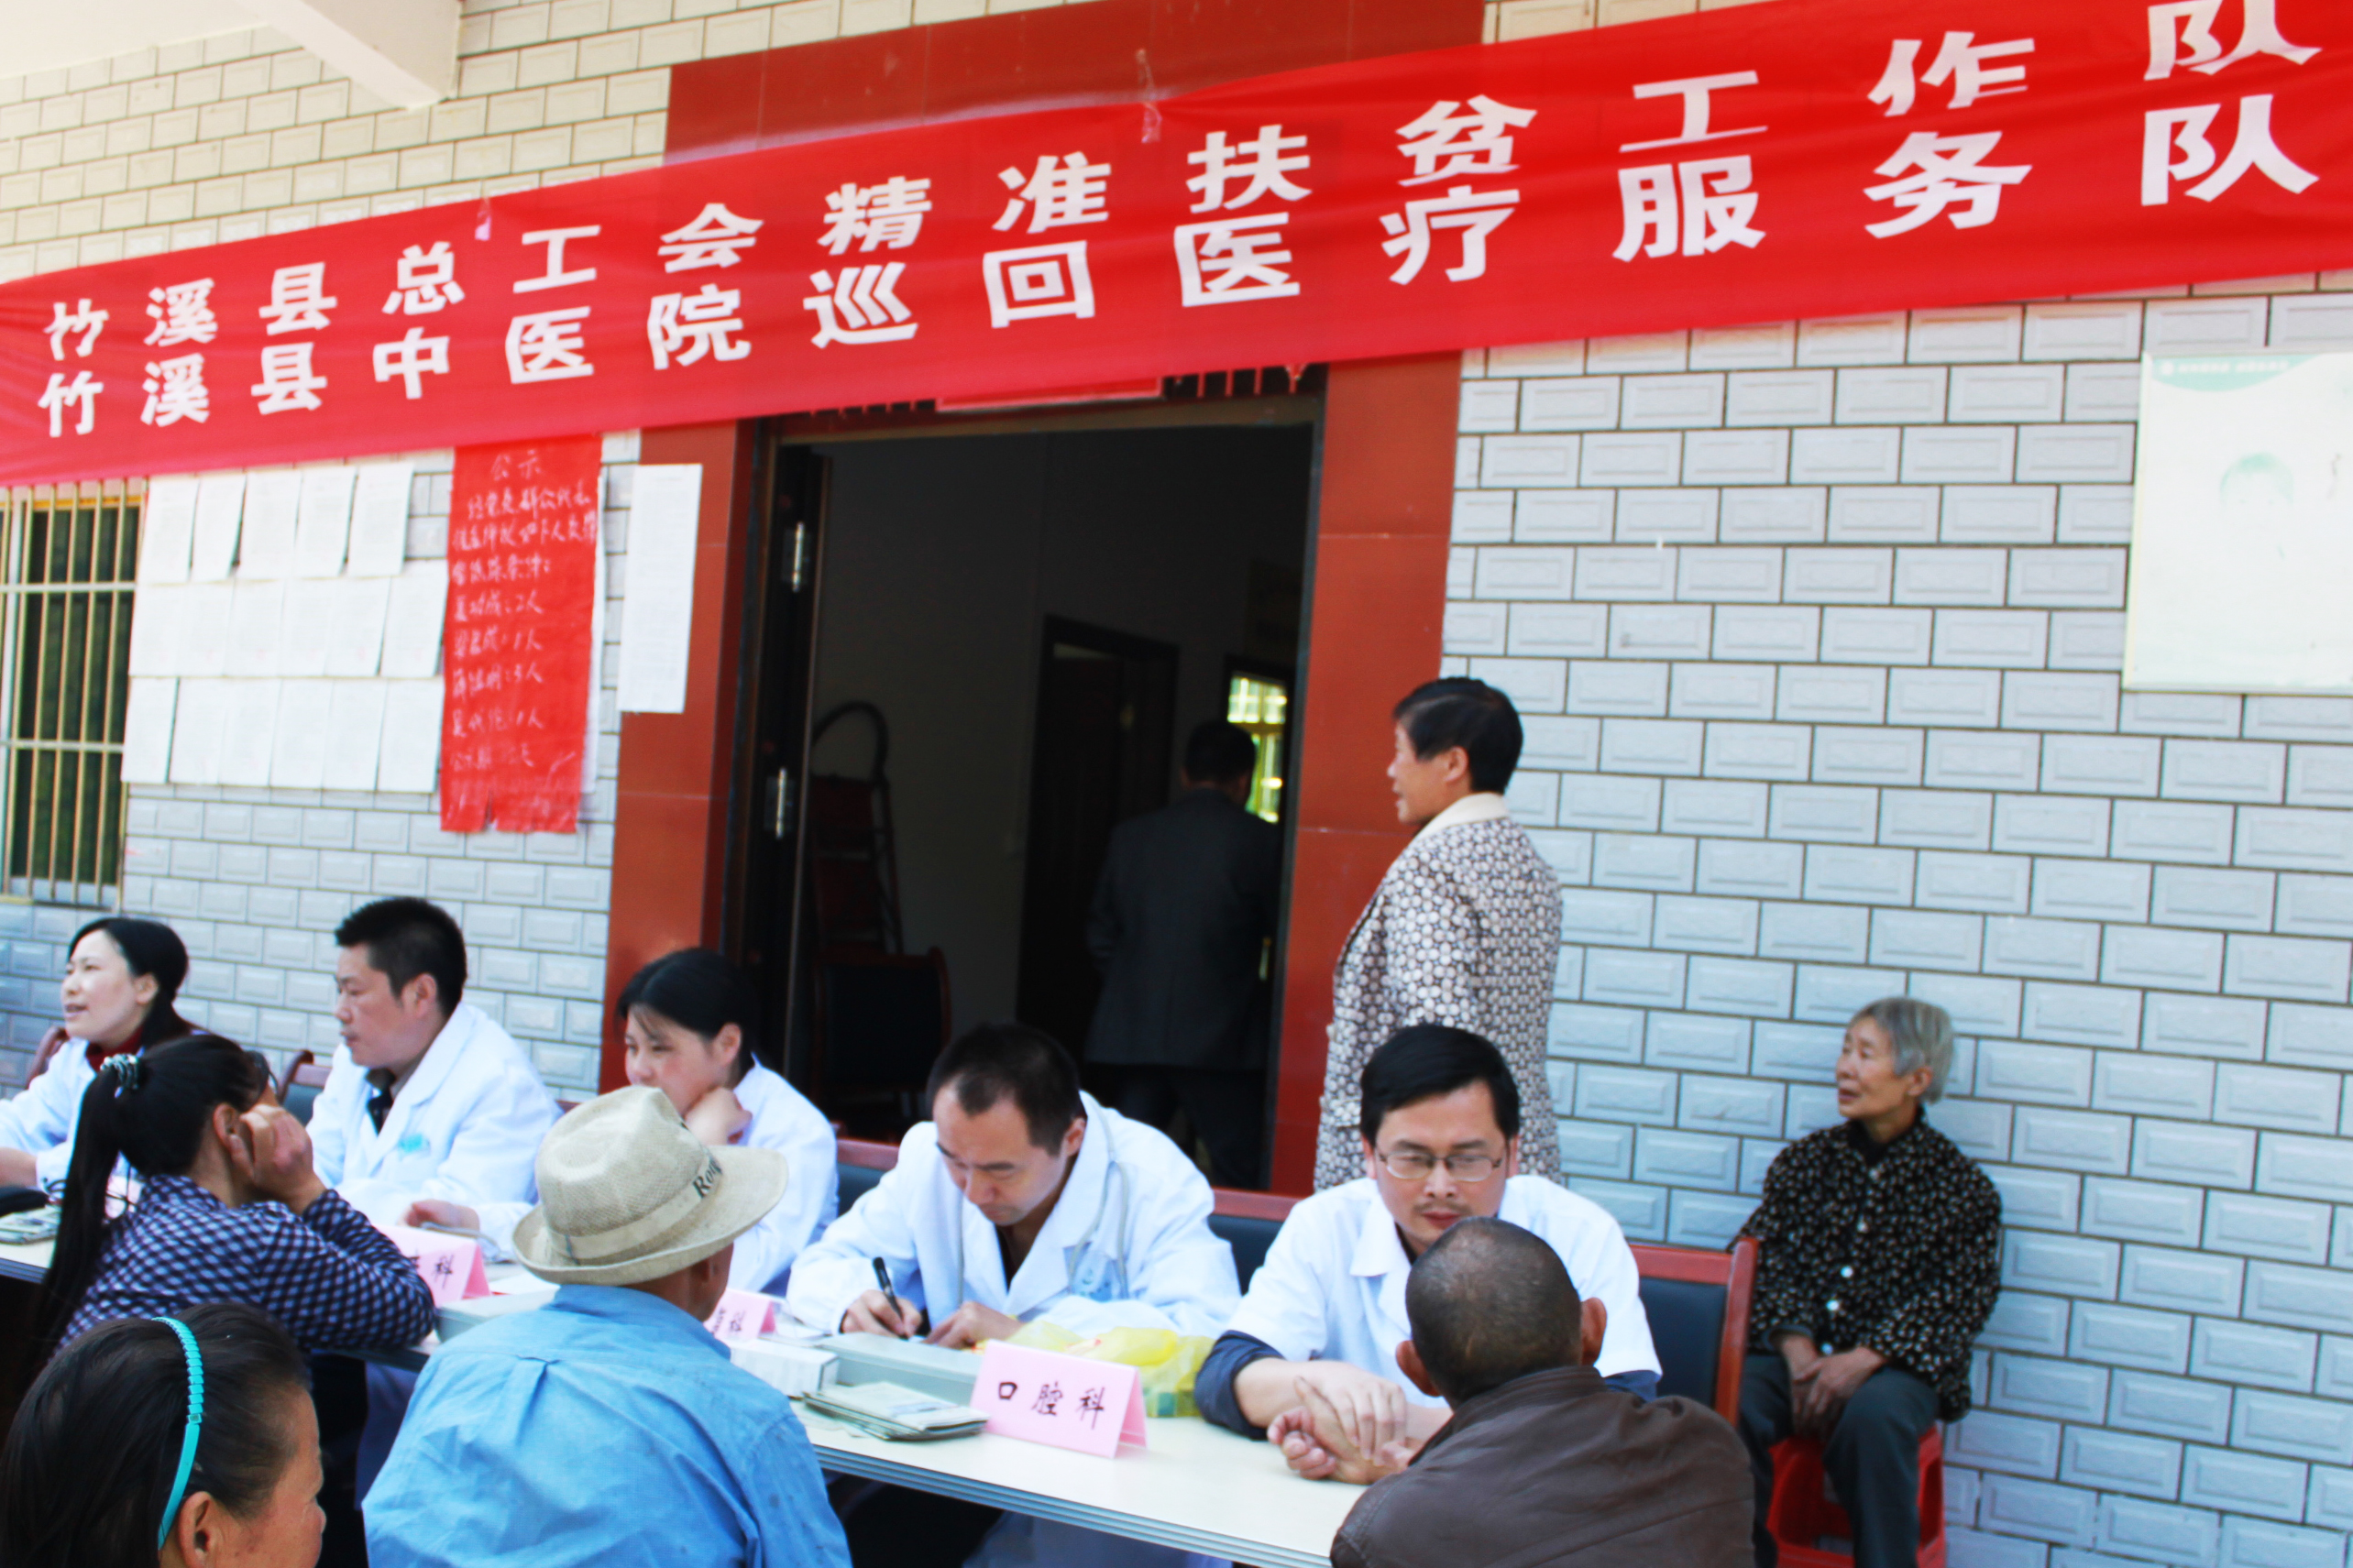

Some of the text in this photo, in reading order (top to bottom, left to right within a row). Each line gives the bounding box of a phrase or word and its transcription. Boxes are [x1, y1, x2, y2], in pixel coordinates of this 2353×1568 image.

[37, 93, 2321, 438] 竹溪县中医院巡回医疗服务队
[42, 0, 2323, 363] 竹溪县总工会精准扶贫工作队
[997, 1379, 1106, 1430] 口腔科
